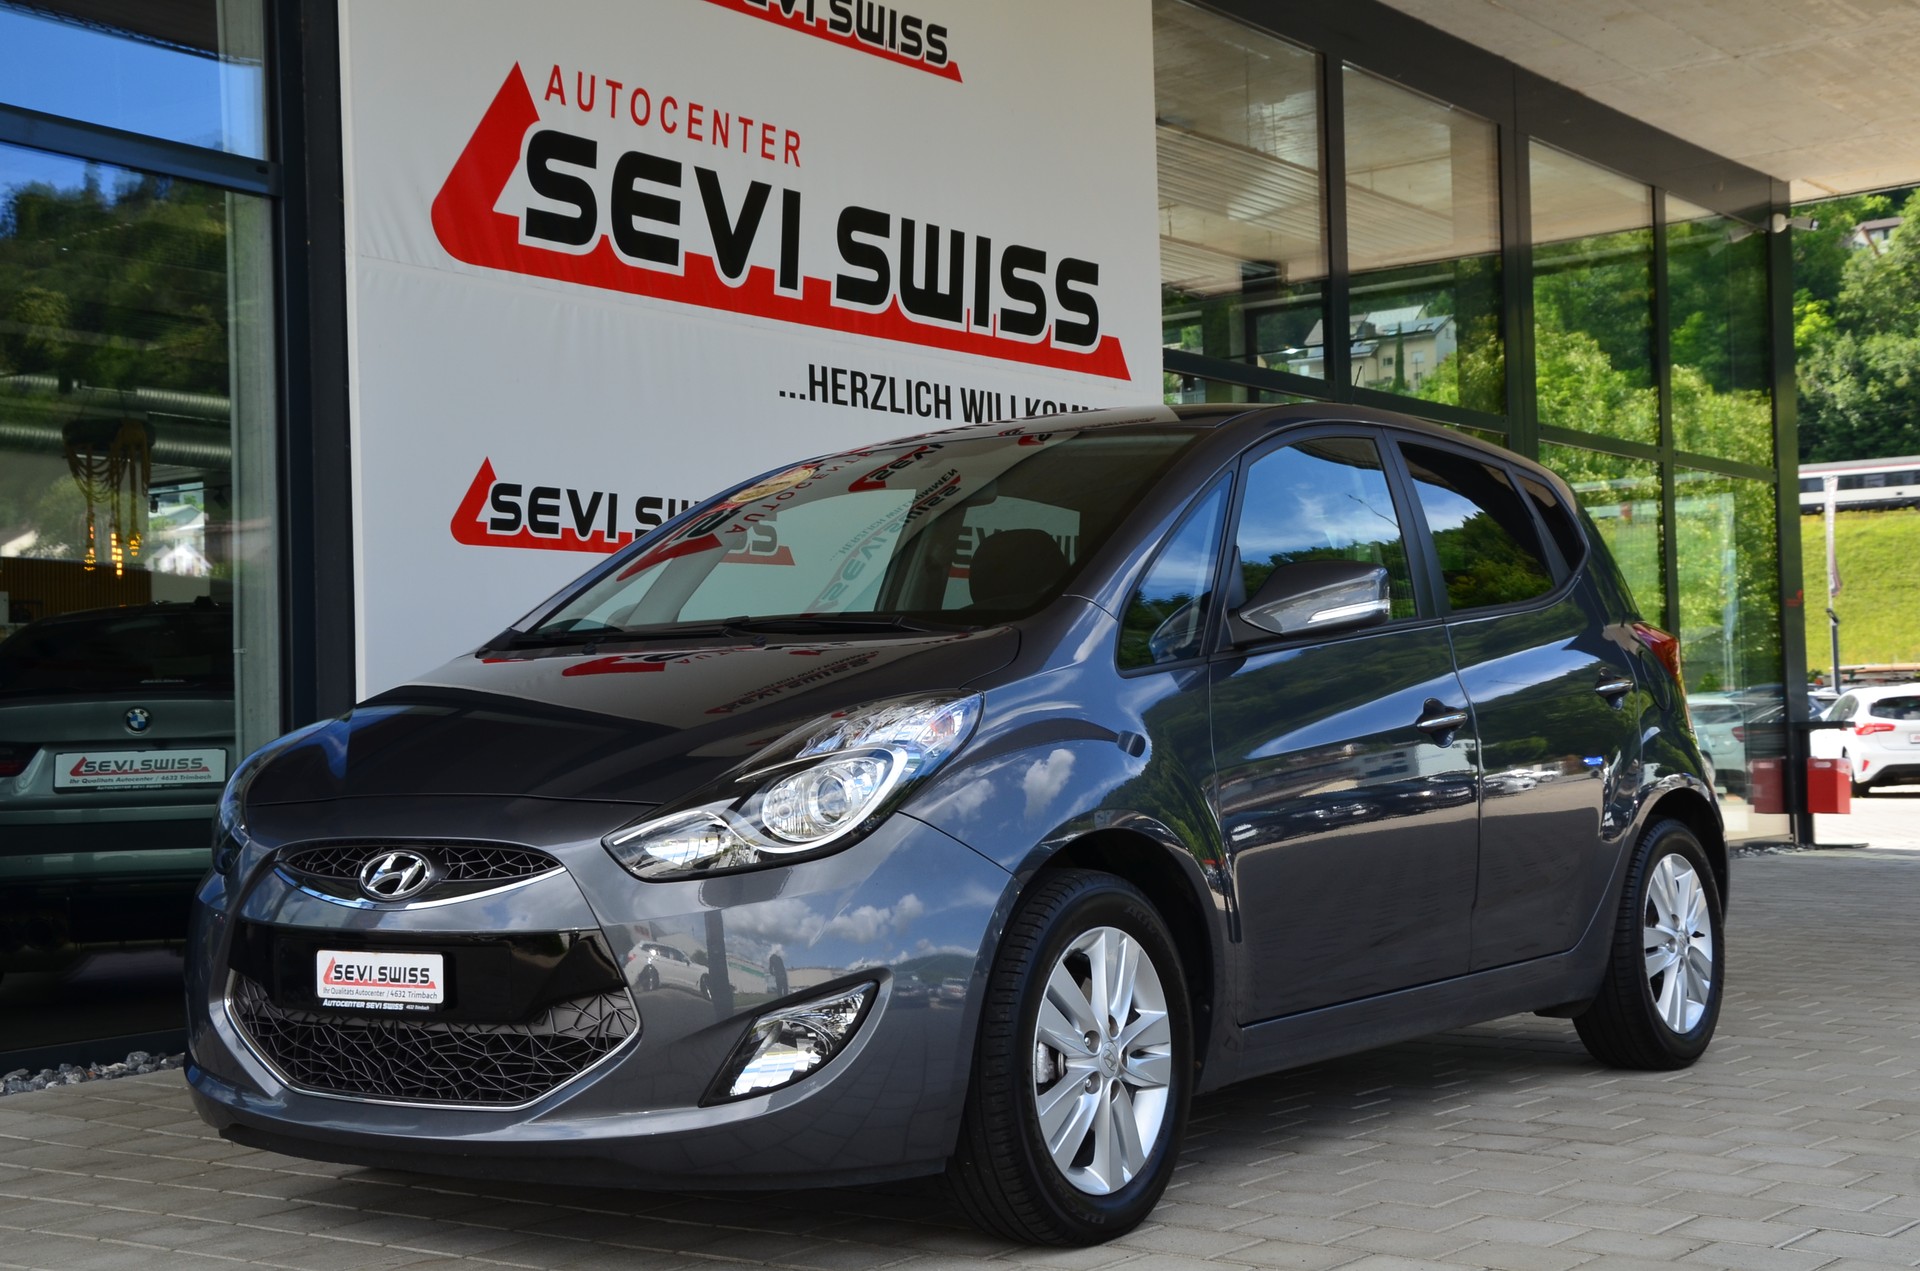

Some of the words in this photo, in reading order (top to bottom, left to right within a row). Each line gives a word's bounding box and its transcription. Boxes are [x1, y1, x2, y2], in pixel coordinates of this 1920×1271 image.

[829, 0, 948, 66] SWISS
[544, 64, 801, 168] AUTOCENTER
[526, 129, 801, 292] SEVI
[836, 205, 1100, 347] SWISS
[489, 482, 618, 539] SEVI
[84, 759, 134, 772] SEVI
[140, 757, 203, 770] SWISS
[333, 964, 372, 981] SEVI
[378, 966, 430, 984] SWISS
[355, 988, 385, 997] Autocenter
[390, 990, 406, 998] 4632
[407, 991, 438, 1000] Trimbach
